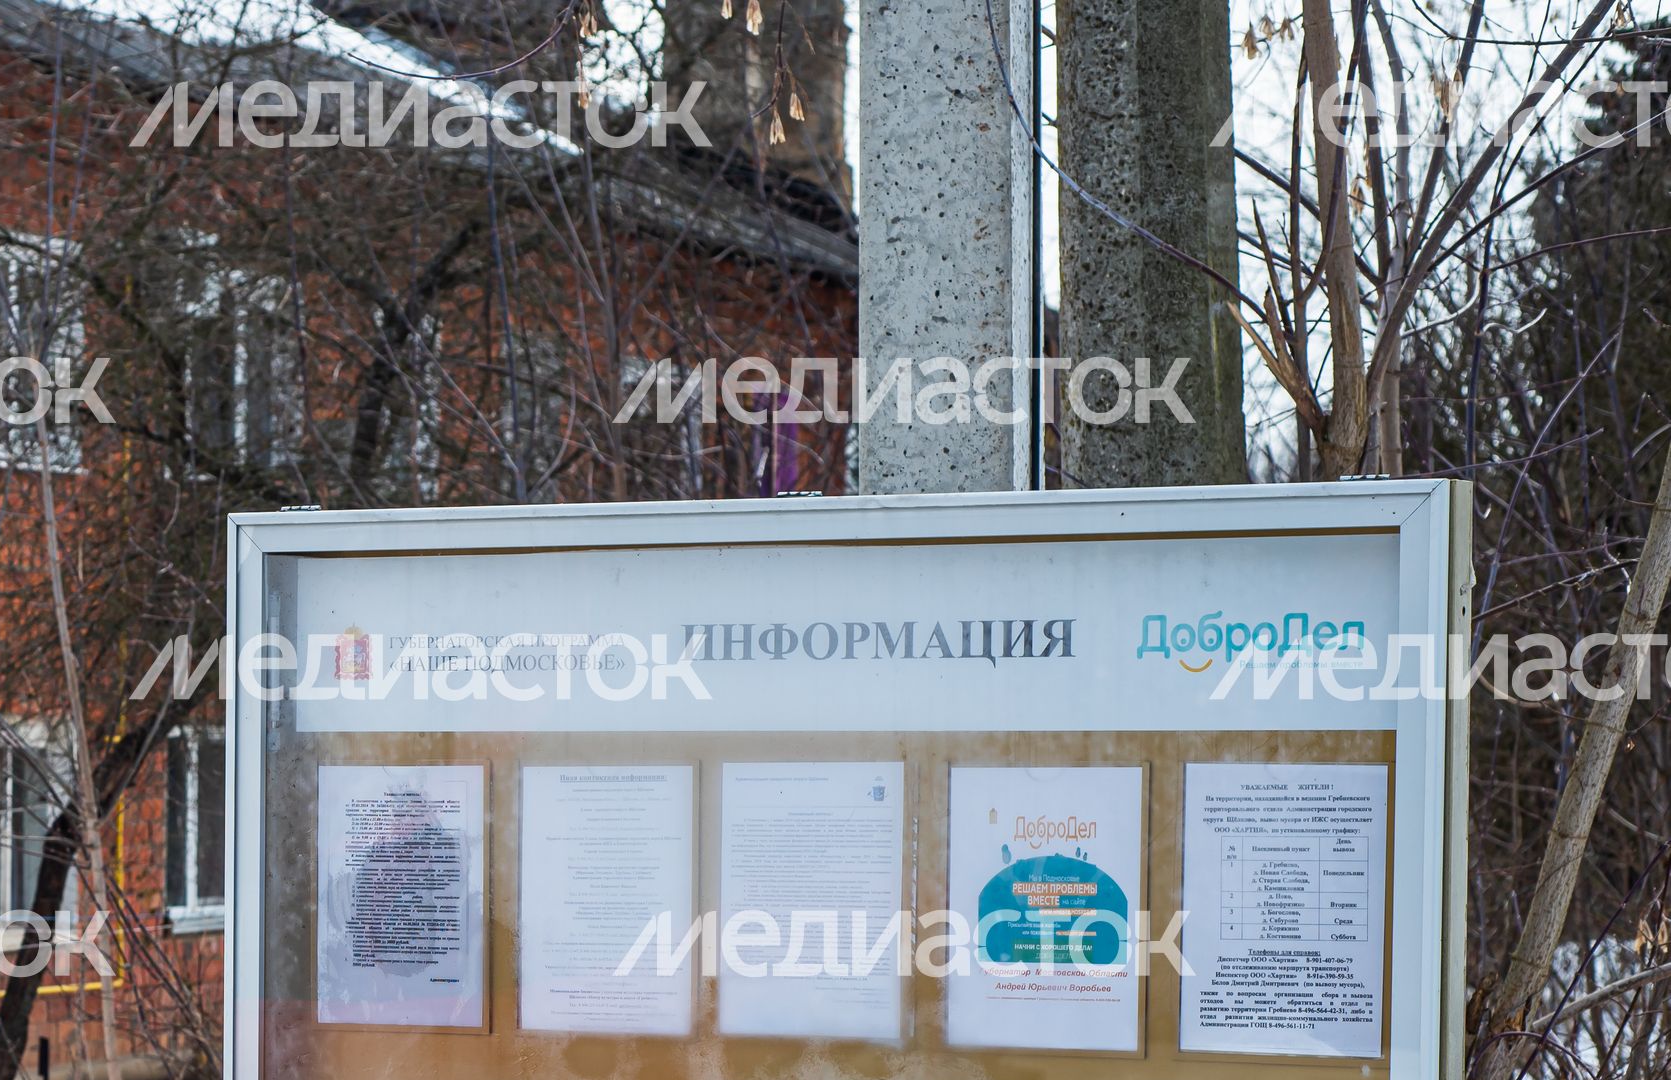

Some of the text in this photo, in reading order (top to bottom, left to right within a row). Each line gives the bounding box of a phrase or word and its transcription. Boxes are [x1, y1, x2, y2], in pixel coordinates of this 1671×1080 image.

[1137, 611, 1364, 663] ДоброДел
[389, 635, 526, 649] ГУБЕРНАТОРСКАЯ
[681, 619, 1076, 668] ИНФОРМАЦИЯ
[389, 654, 625, 674] «НАШЕ ПОДМОСКОВЬЕ»
[1328, 795, 1370, 803] Гребневского
[1014, 815, 1096, 843] ДоброДел
[1013, 883, 1097, 893] РЕШАЕМ ПРОБЛЕМЫ
[1028, 896, 1060, 905] ВМЕСТЕ
[1217, 956, 1250, 964] Диспетчер
[984, 968, 1030, 977] убернатор
[995, 983, 1026, 991] Андрей
[1069, 984, 1111, 992] Воробьев
[1231, 980, 1259, 988] Дмитрий
[1260, 980, 1299, 988] Дмитриевич
[1287, 999, 1322, 1007] обратиться
